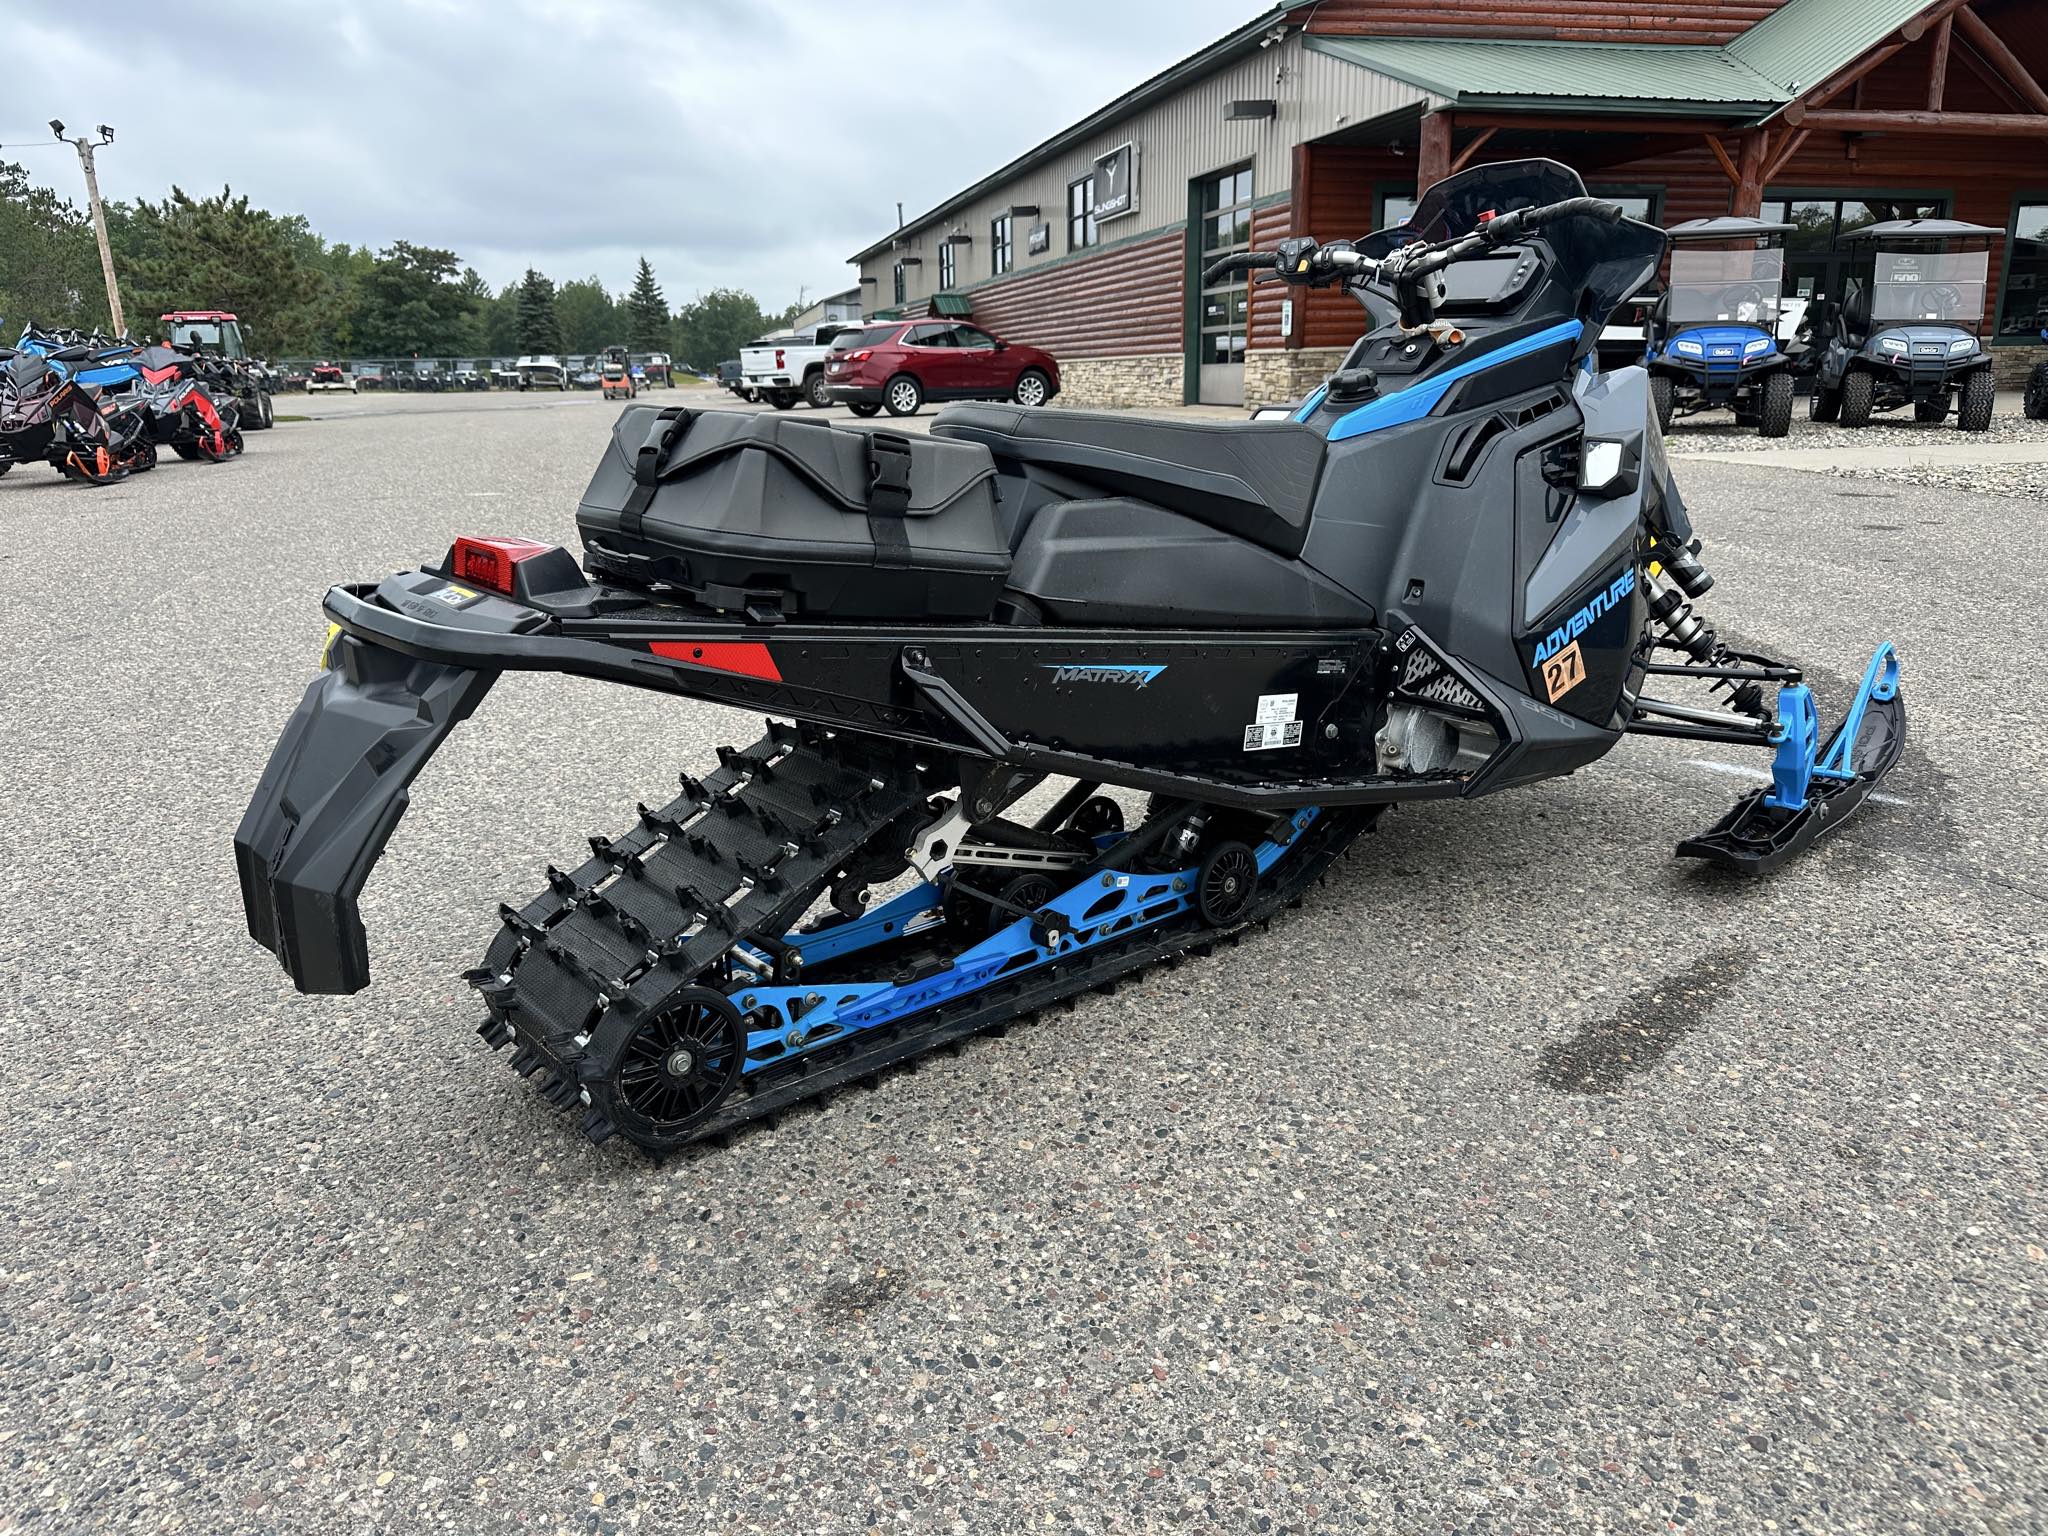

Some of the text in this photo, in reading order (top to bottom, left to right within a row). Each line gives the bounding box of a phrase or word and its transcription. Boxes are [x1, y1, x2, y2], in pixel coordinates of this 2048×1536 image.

[49, 384, 73, 408] POLARIS
[1532, 567, 1635, 669] ADVENTURE
[1051, 666, 1149, 688] MATRYX
[1548, 650, 1577, 695] 27
